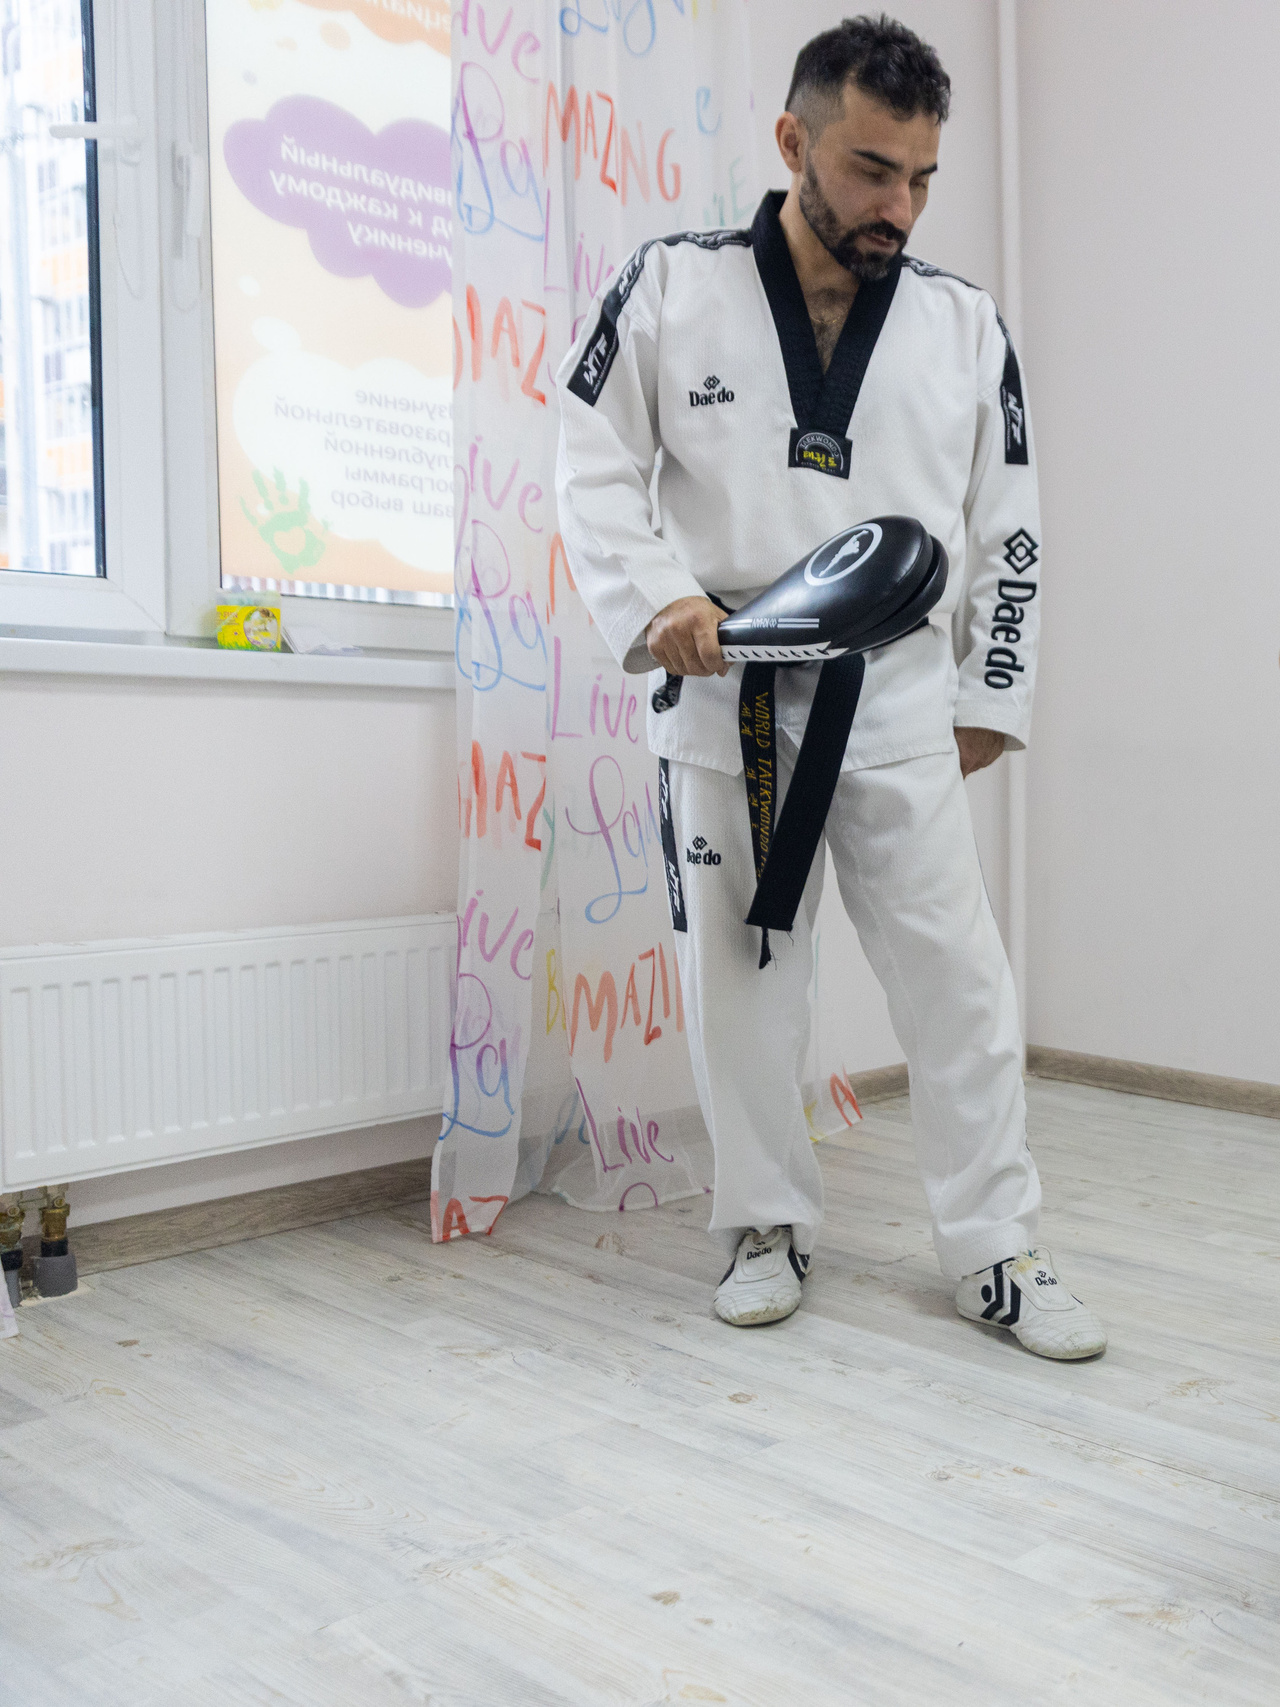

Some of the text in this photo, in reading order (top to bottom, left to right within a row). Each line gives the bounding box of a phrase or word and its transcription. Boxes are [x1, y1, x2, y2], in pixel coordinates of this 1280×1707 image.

[689, 386, 735, 407] Daedo
[800, 435, 840, 458] TAEKWONDO
[984, 578, 1037, 690] Daedo
[550, 635, 640, 744] Live
[755, 691, 771, 748] WORLD
[758, 758, 772, 852] TAEKWONDO
[574, 1076, 675, 1173] Live
